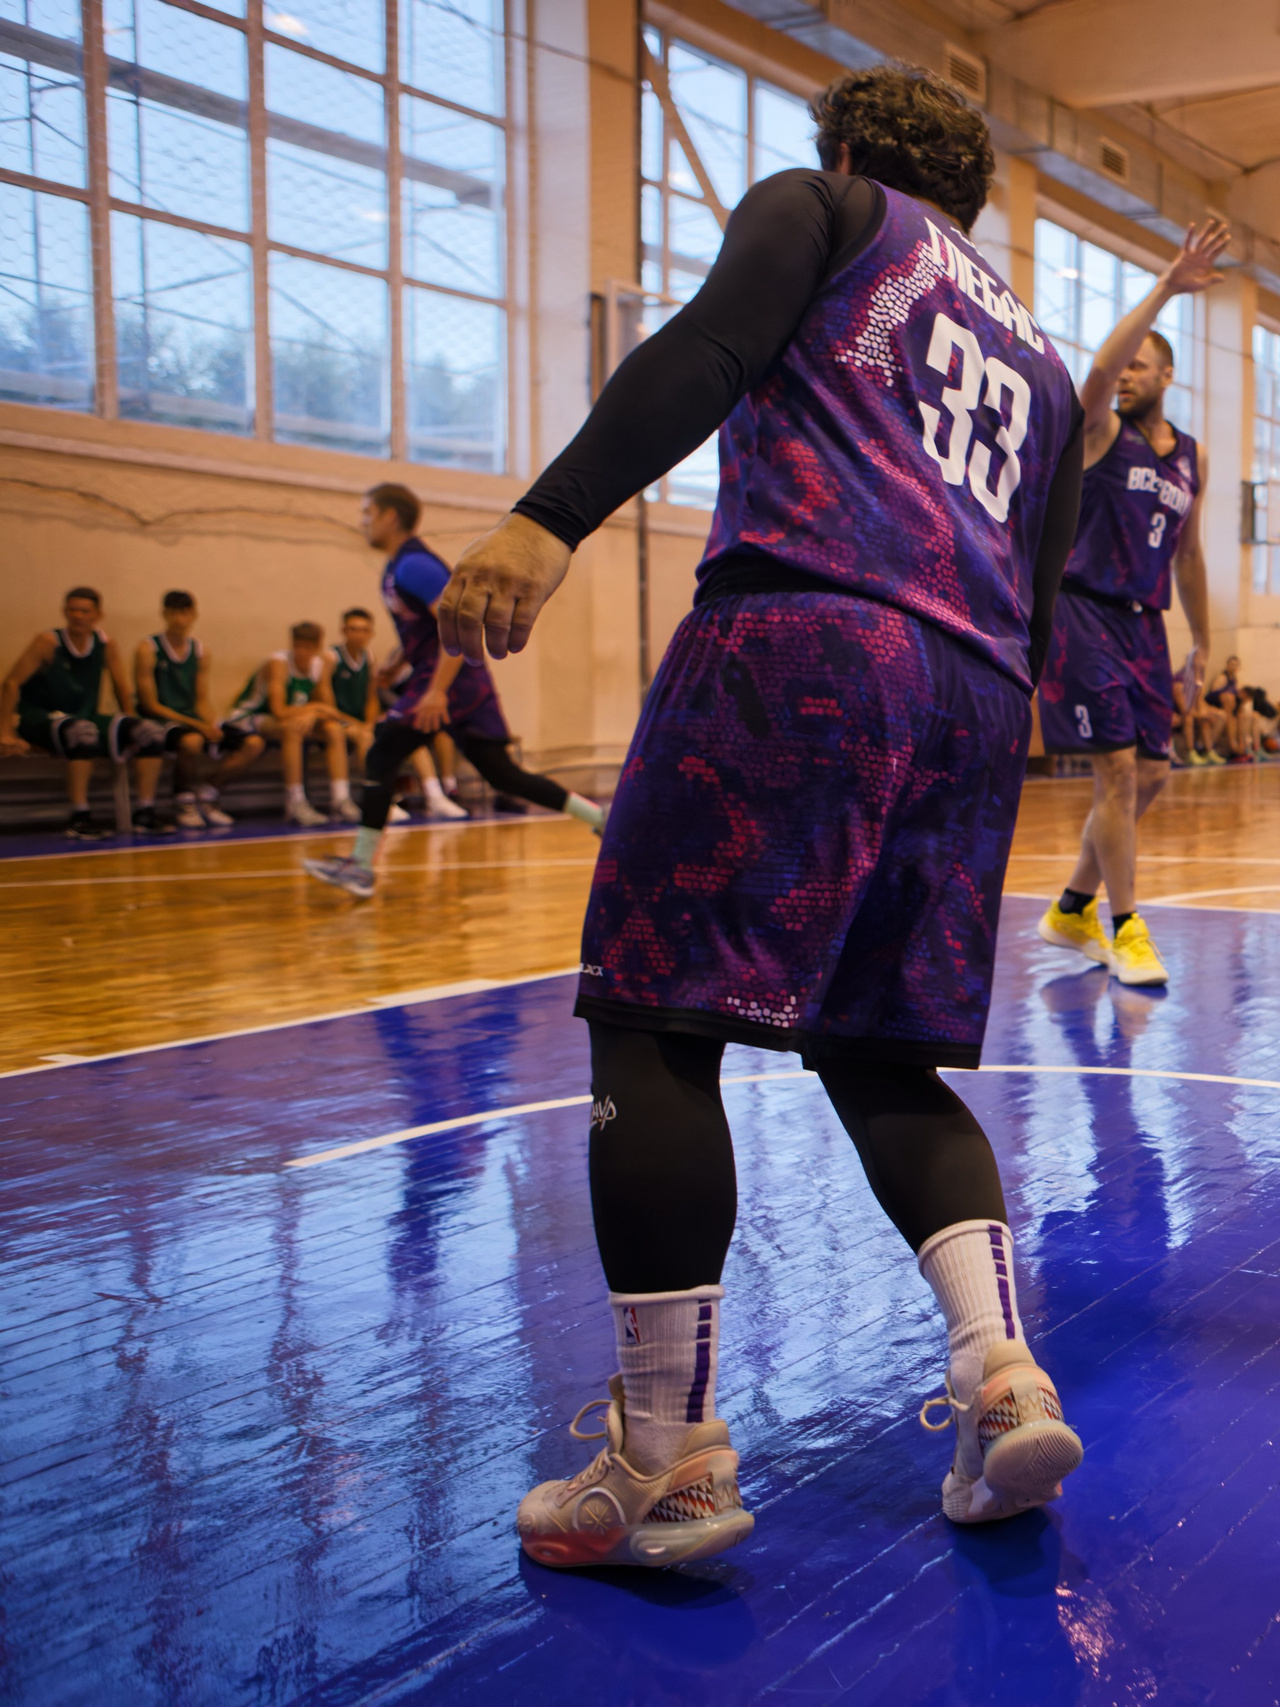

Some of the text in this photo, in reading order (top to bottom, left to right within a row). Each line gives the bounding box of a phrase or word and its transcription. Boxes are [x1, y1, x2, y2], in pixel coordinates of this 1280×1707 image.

[918, 312, 1031, 523] 33
[1148, 512, 1167, 549] 3
[1074, 704, 1093, 738] 3
